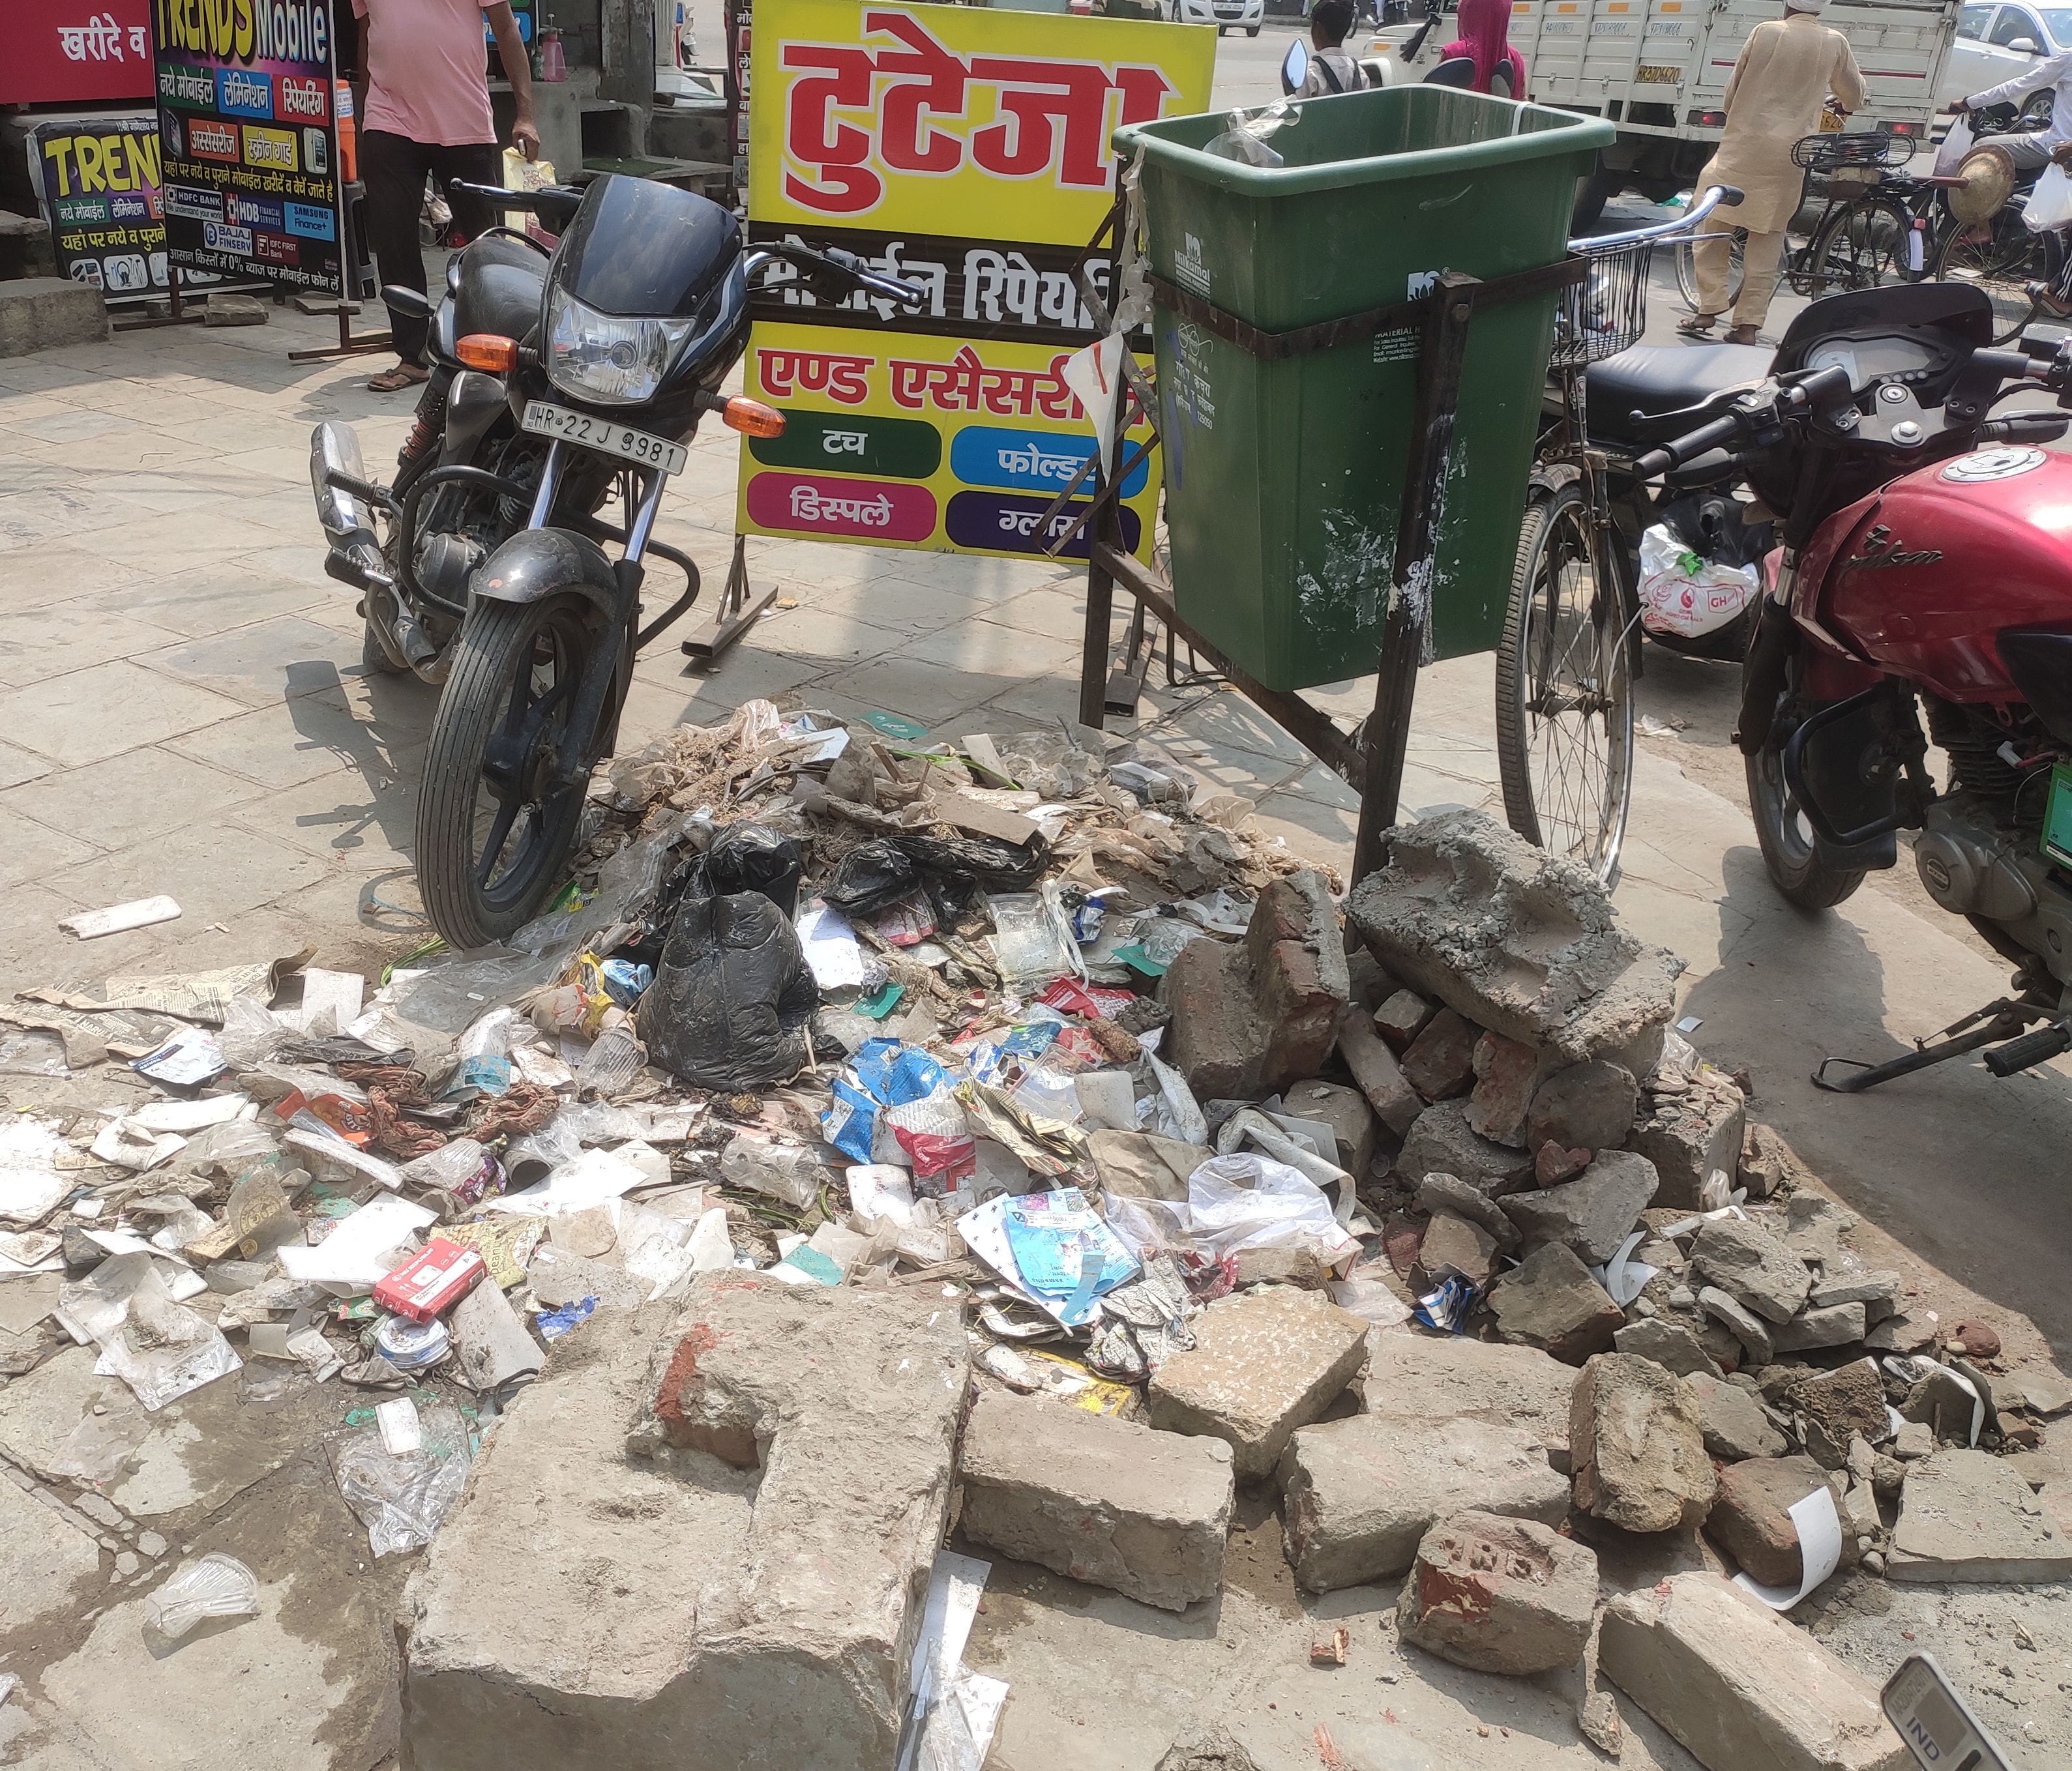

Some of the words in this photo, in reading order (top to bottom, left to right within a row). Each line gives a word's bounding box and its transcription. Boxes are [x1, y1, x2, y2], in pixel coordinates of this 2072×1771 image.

[160, 65, 176, 98] नये
[223, 71, 269, 110] लेमिनेशन
[282, 77, 325, 117] रिपेयरिंग
[779, 7, 1181, 216] टुटेजा
[45, 134, 161, 197] TREN
[179, 164, 189, 177] पर
[190, 160, 203, 179] नये
[211, 165, 230, 190] पुराने
[307, 179, 325, 199] जाते
[111, 198, 145, 218] लेमिनेशन
[178, 188, 198, 201] HDFC
[200, 192, 221, 207] BANK
[60, 203, 74, 221] नये
[175, 206, 200, 217] understand
[200, 208, 209, 220] your
[209, 209, 222, 220] world
[239, 201, 259, 223] HDB
[294, 206, 328, 220] SAMSUNG
[295, 218, 327, 231] Finance+
[88, 232, 106, 248] पर
[106, 225, 127, 246] नये
[219, 226, 250, 240] BAJAJ
[220, 237, 250, 252] FINSERV
[270, 241, 280, 250] IDFC
[282, 242, 296, 252] FIRST
[271, 249, 283, 259] Bank
[170, 248, 194, 262] आसान
[228, 257, 244, 272] 0%
[267, 266, 278, 279] पर
[311, 271, 329, 289] फोन
[1174, 249, 1210, 282] Nilkamal
[756, 348, 874, 404] एण्ड
[535, 406, 554, 429] HR
[563, 415, 591, 439] 22
[597, 426, 611, 444] J
[822, 430, 868, 456] टच
[790, 486, 894, 526] डिस्पले
[1906, 1716, 1940, 1761] IND
